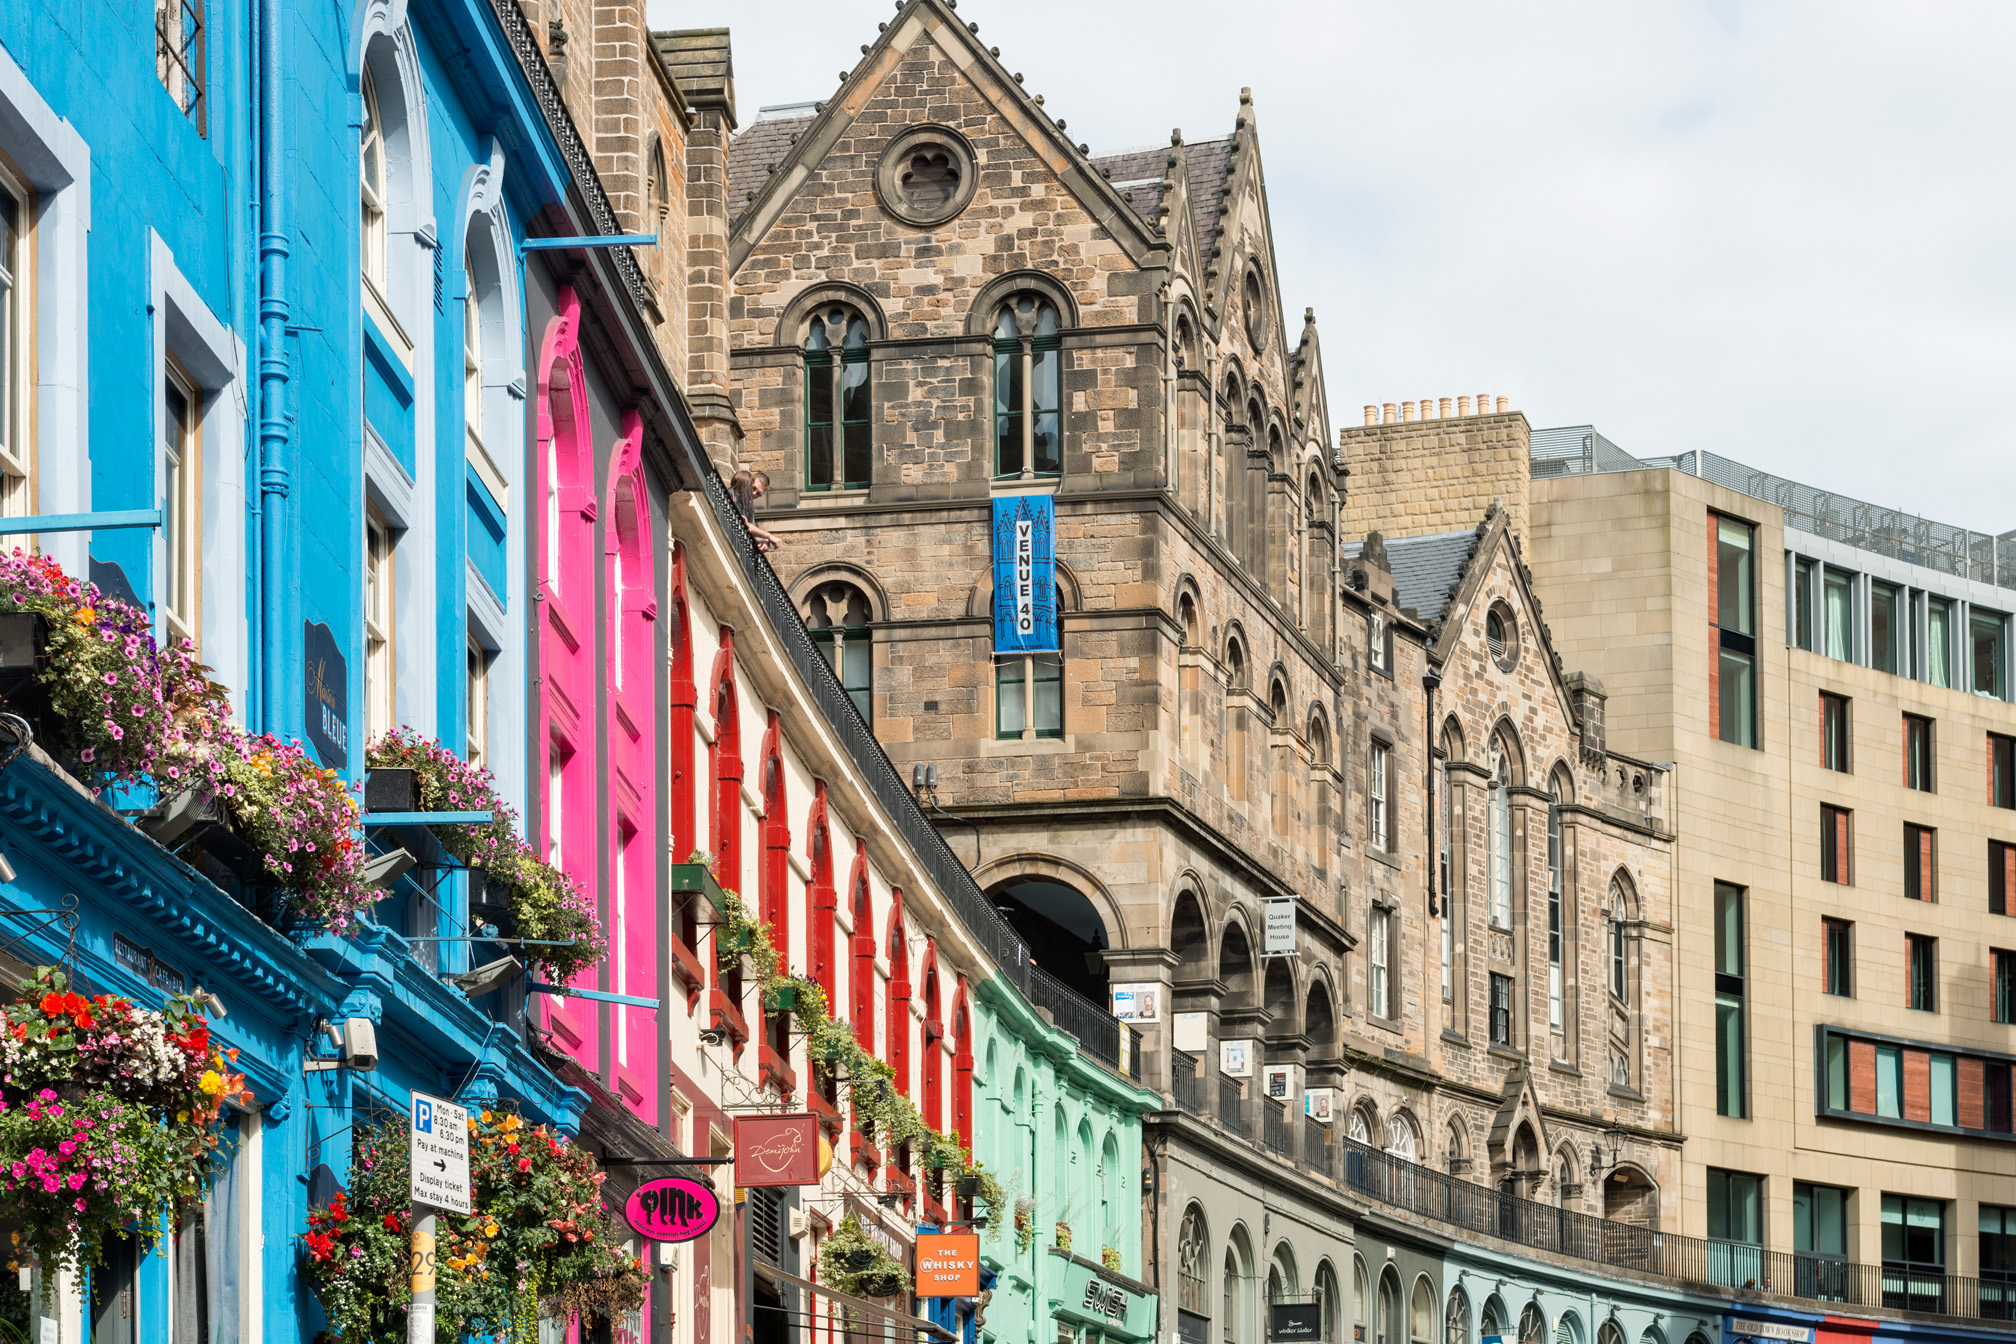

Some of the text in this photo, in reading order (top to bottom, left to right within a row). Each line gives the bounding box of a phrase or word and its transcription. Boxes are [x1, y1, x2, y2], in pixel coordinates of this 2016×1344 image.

[1018, 525, 1031, 630] VENUE 40
[322, 703, 347, 753] BLEUE
[115, 938, 147, 971] RESTAURANT
[419, 1103, 430, 1129] P
[434, 1115, 448, 1128] 8.30
[449, 1122, 458, 1130] am
[437, 1104, 449, 1116] Mon
[454, 1109, 464, 1121] Sat
[440, 1129, 464, 1145] 6.30 pm
[417, 1138, 463, 1160] Pay at machine
[749, 1143, 801, 1160] Demijohn
[420, 1172, 463, 1193] Display ticket
[414, 1186, 469, 1209] Max stay 4 hours
[634, 1219, 655, 1235] delicious
[889, 1236, 902, 1261] SHOP
[411, 1251, 436, 1276] 29
[922, 1261, 974, 1270] WHISKY
[1736, 1321, 1806, 1339] THE OLD TOWN BOOKSHOP
